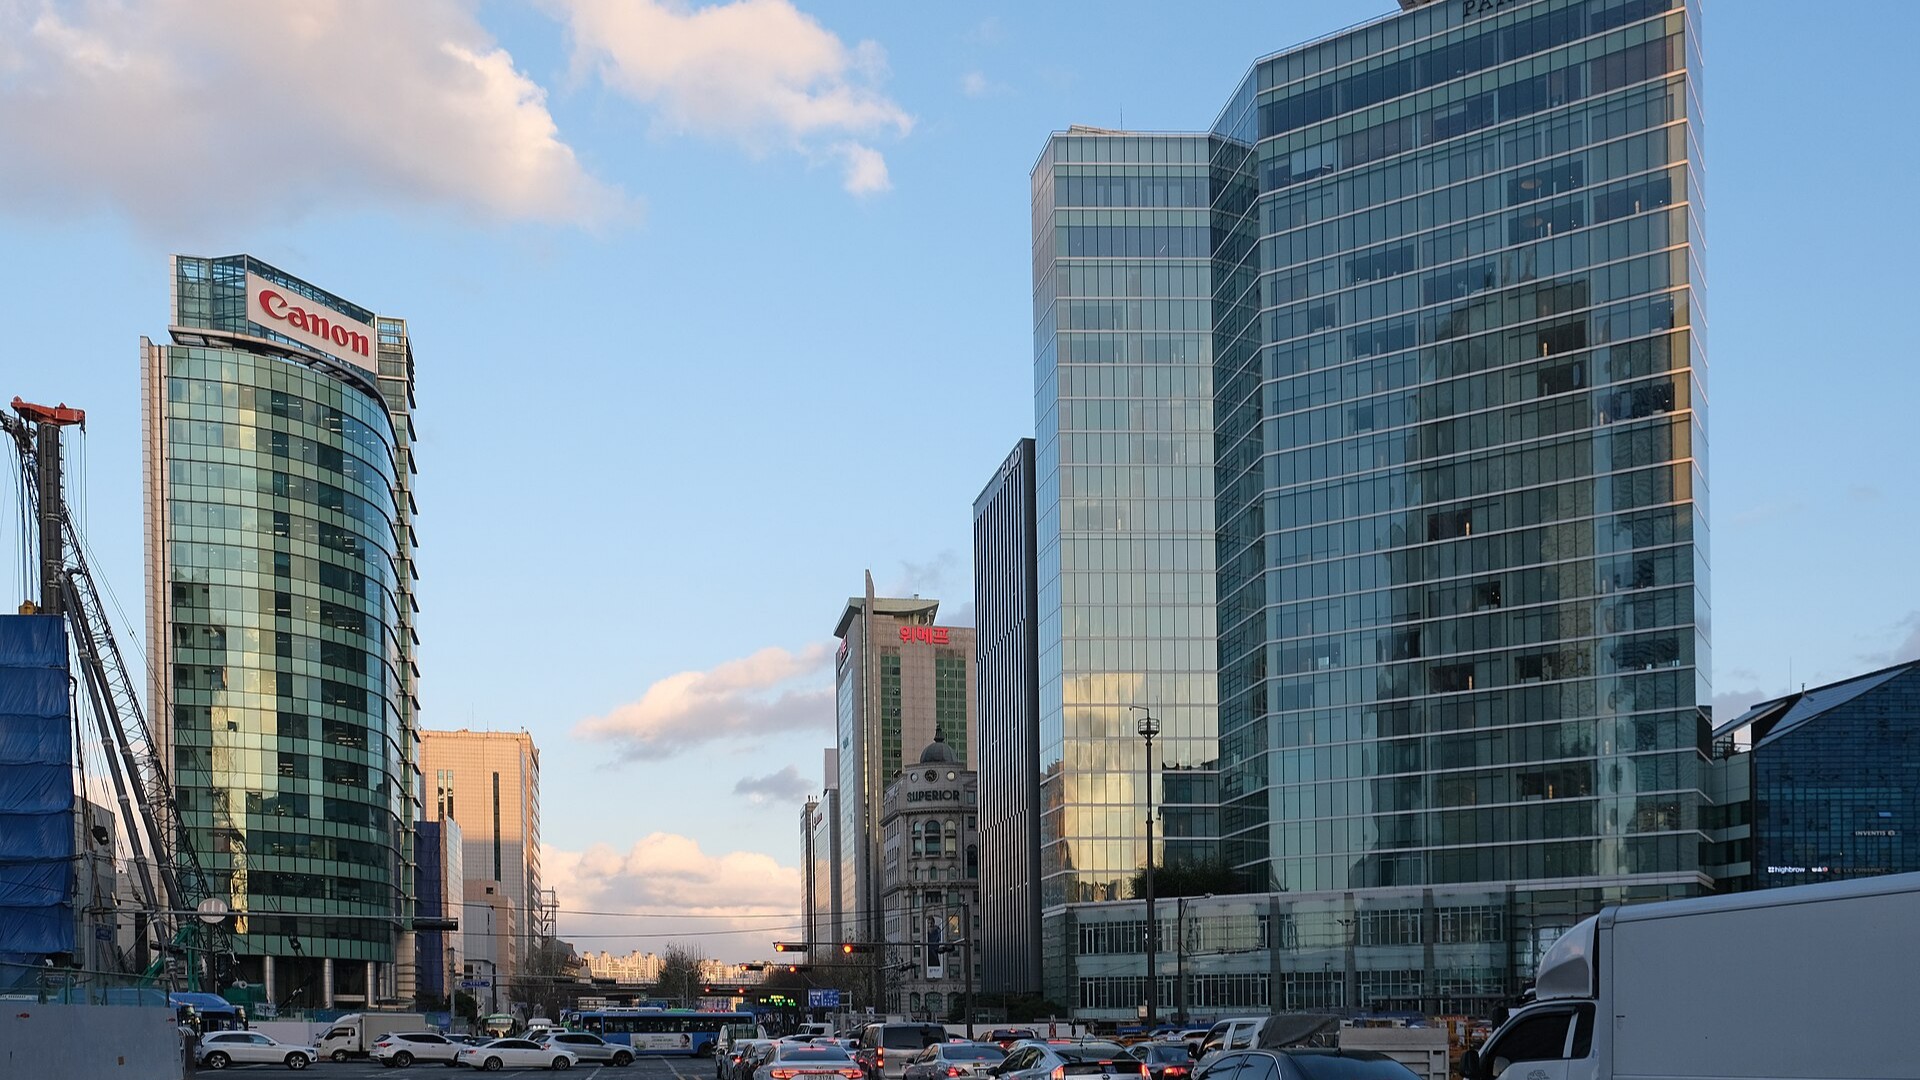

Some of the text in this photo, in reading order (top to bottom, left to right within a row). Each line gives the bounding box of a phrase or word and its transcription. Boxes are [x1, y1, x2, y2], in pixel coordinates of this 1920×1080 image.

[1463, 0, 1514, 17] PA
[258, 290, 369, 357] Canon
[1001, 447, 1021, 482] GLAD
[899, 625, 949, 645] 위메프
[906, 790, 960, 802] SUPERIOR
[1774, 866, 1806, 874] highbrow
